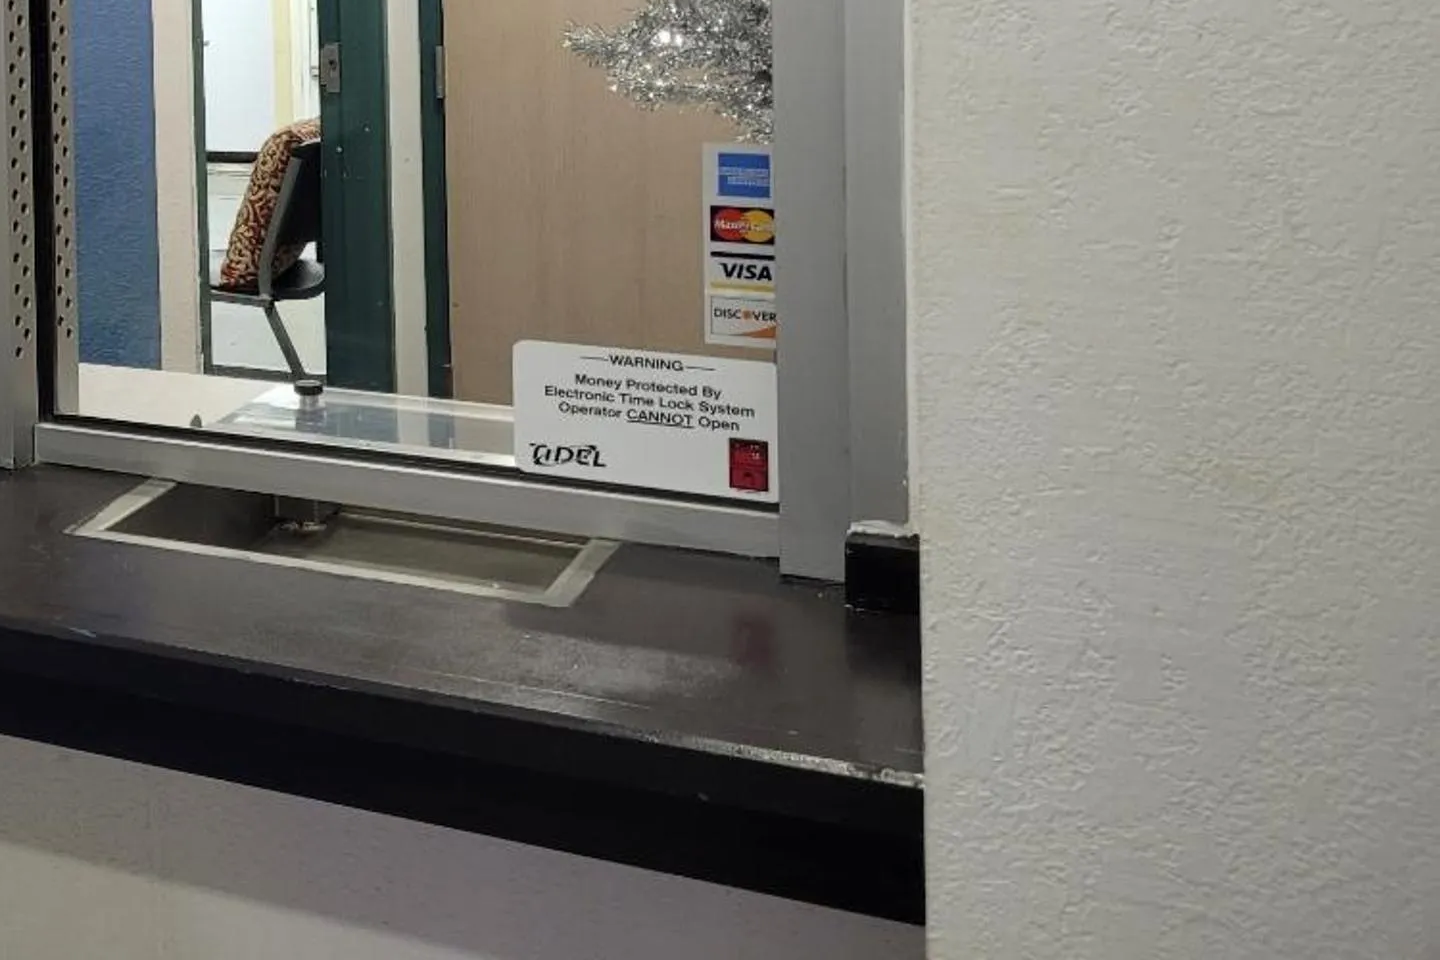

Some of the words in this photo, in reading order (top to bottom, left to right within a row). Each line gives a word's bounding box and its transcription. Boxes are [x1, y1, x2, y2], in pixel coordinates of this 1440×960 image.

[720, 263, 772, 281] VISA
[713, 308, 776, 322] DISCOVER
[610, 355, 684, 371] WARNING
[575, 374, 622, 391] Money
[626, 378, 698, 397] Protected
[702, 386, 721, 400] By
[544, 385, 615, 403] Electronic
[619, 394, 654, 407] Time
[660, 397, 694, 411] Lock
[699, 401, 755, 418] System
[558, 402, 622, 419] Operator
[626, 409, 693, 427] CANNOT
[698, 416, 740, 431] Open
